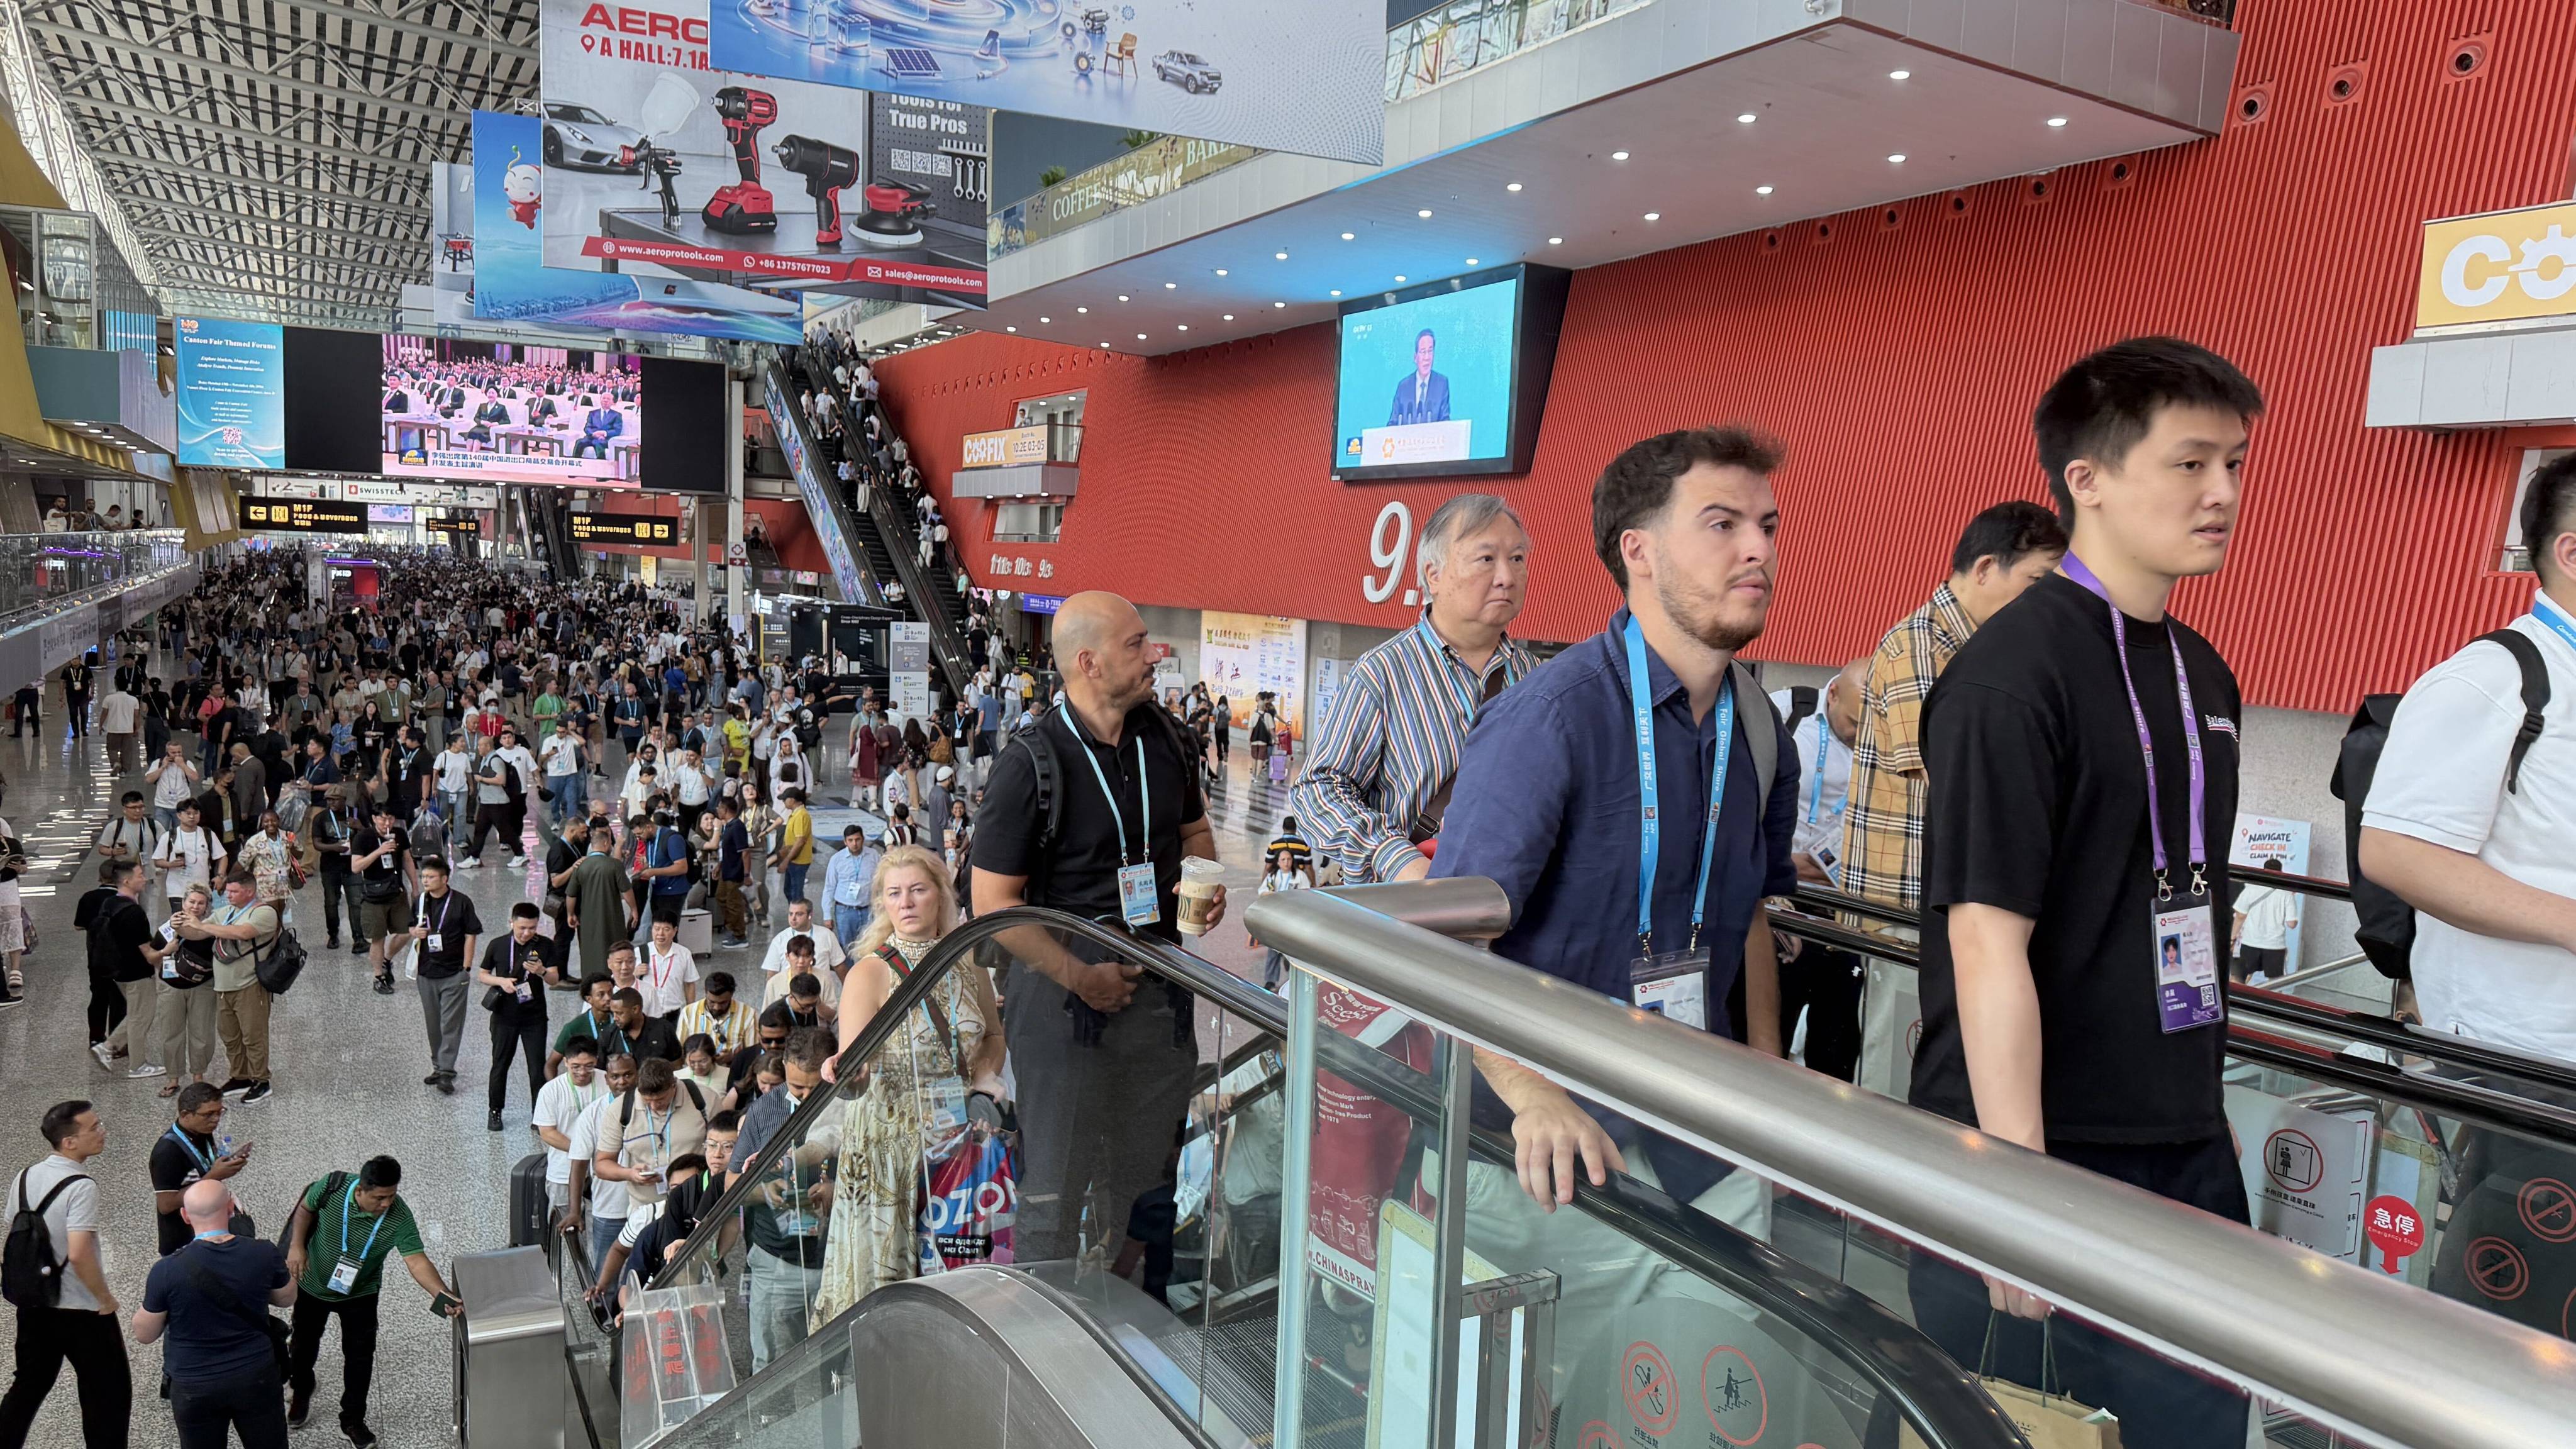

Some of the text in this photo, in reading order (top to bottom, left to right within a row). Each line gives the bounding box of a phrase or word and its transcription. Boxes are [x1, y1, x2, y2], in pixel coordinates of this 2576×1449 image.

[600, 37, 613, 57] A
[889, 109, 967, 135] True Pros
[1053, 183, 1101, 221] COFFEE
[619, 243, 724, 263] www.aeroprotools.com
[758, 258, 831, 275] +86 13757677023
[885, 267, 982, 287] sales@aeroprotools.com
[184, 336, 208, 345] Canton
[224, 340, 250, 348] Themed
[252, 341, 276, 350] Forums
[1013, 440, 1044, 453] 10.2E 03-05
[1719, 708, 1728, 726] Fair
[1718, 730, 1728, 760] Global
[1641, 752, 1653, 790] 广交世界
[1714, 765, 1724, 792] Share
[2248, 833, 2291, 843] NAVIGATE
[2373, 1208, 2416, 1235] 急停
[2368, 1226, 2420, 1247] Emergency Stop
